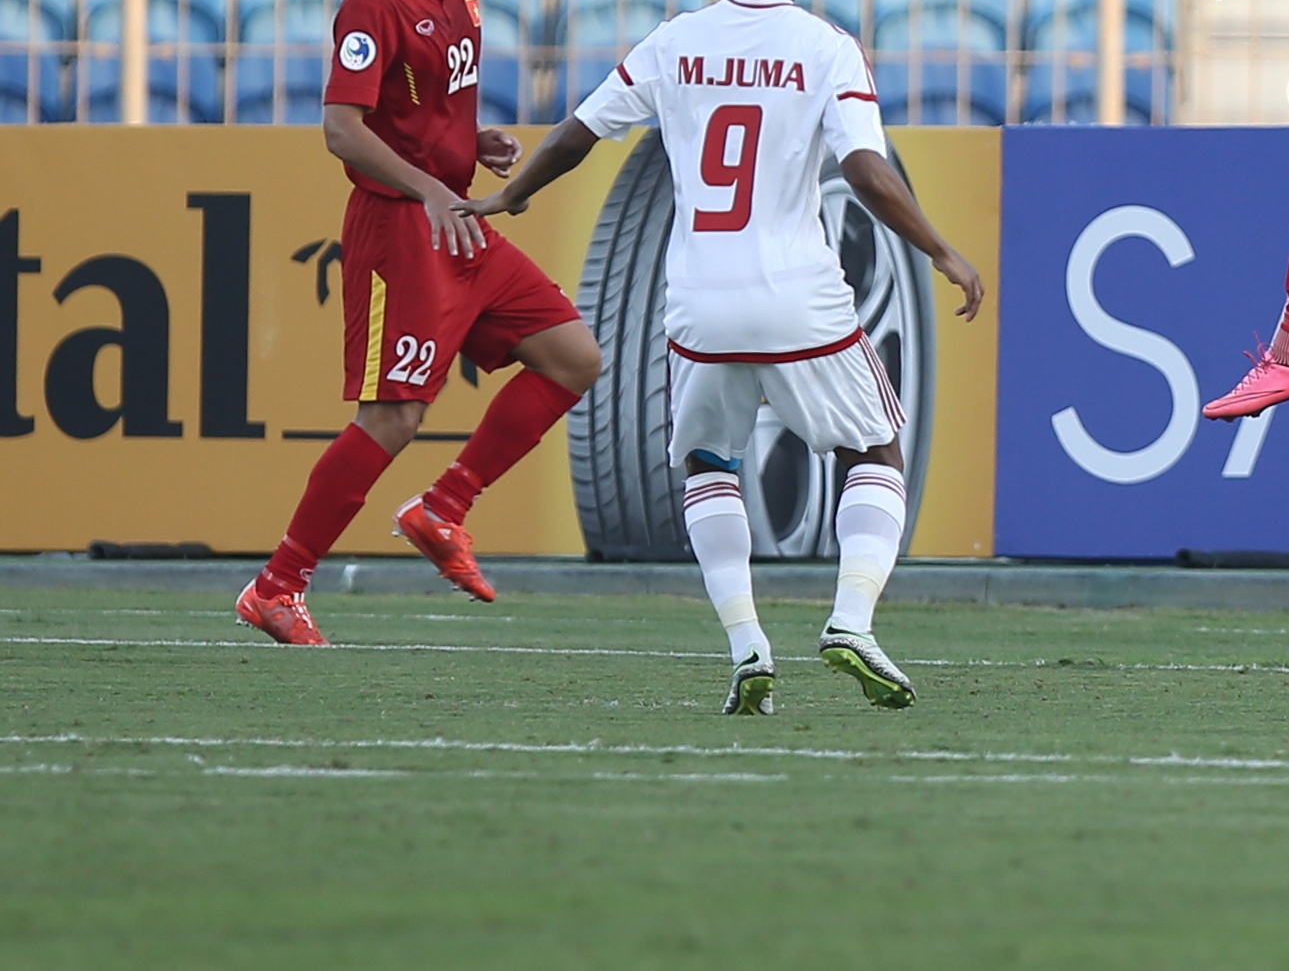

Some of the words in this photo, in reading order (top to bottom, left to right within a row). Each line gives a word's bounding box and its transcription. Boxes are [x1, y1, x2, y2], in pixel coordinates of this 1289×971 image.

[448, 37, 478, 95] 22
[678, 56, 806, 92] M.JUMA
[692, 104, 763, 232] 9
[386, 335, 437, 386] 22
